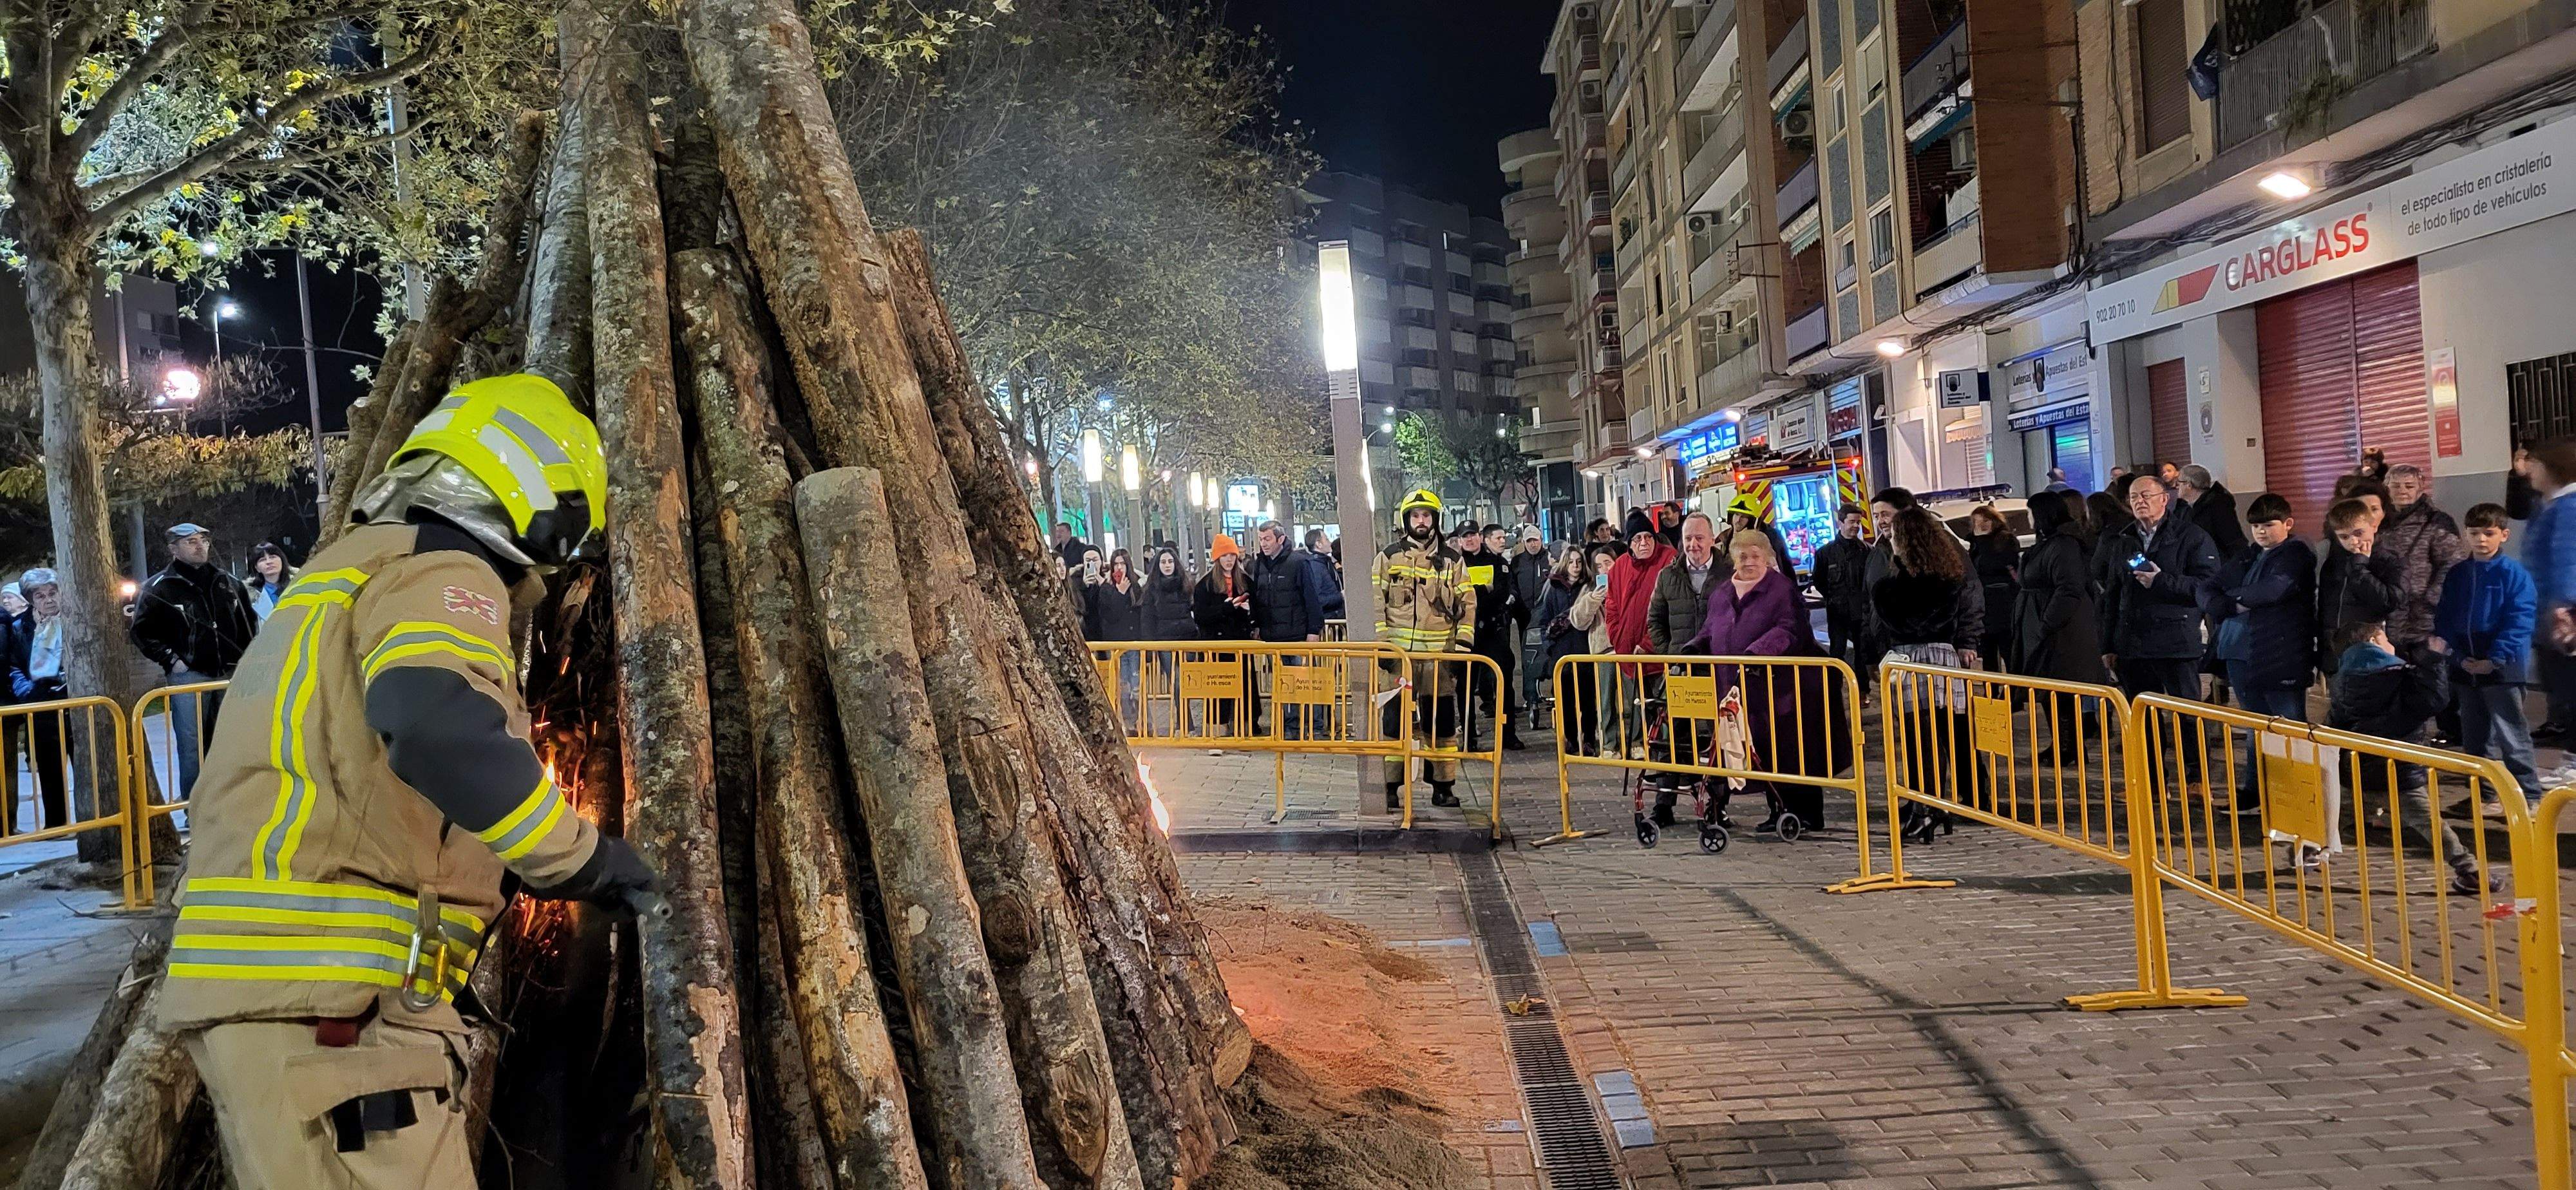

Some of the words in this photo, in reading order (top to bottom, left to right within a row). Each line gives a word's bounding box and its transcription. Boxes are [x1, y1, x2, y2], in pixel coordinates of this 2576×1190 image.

[2401, 198, 2410, 215] el
[2413, 180, 2474, 212] especialista
[2477, 175, 2491, 190] en
[2494, 151, 2552, 185] cristalería
[2408, 221, 2420, 236] de
[2423, 212, 2447, 232] todo
[2450, 206, 2470, 225] tipo
[2473, 200, 2488, 216] de
[2490, 181, 2547, 211] vehículos
[2225, 213, 2369, 291] CARGLASS
[2096, 308, 2107, 324] 902
[2108, 305, 2117, 320] 20
[2117, 301, 2126, 317] 70
[2128, 299, 2136, 314] 10
[2069, 356, 2078, 370] del
[2066, 406, 2074, 417] del
